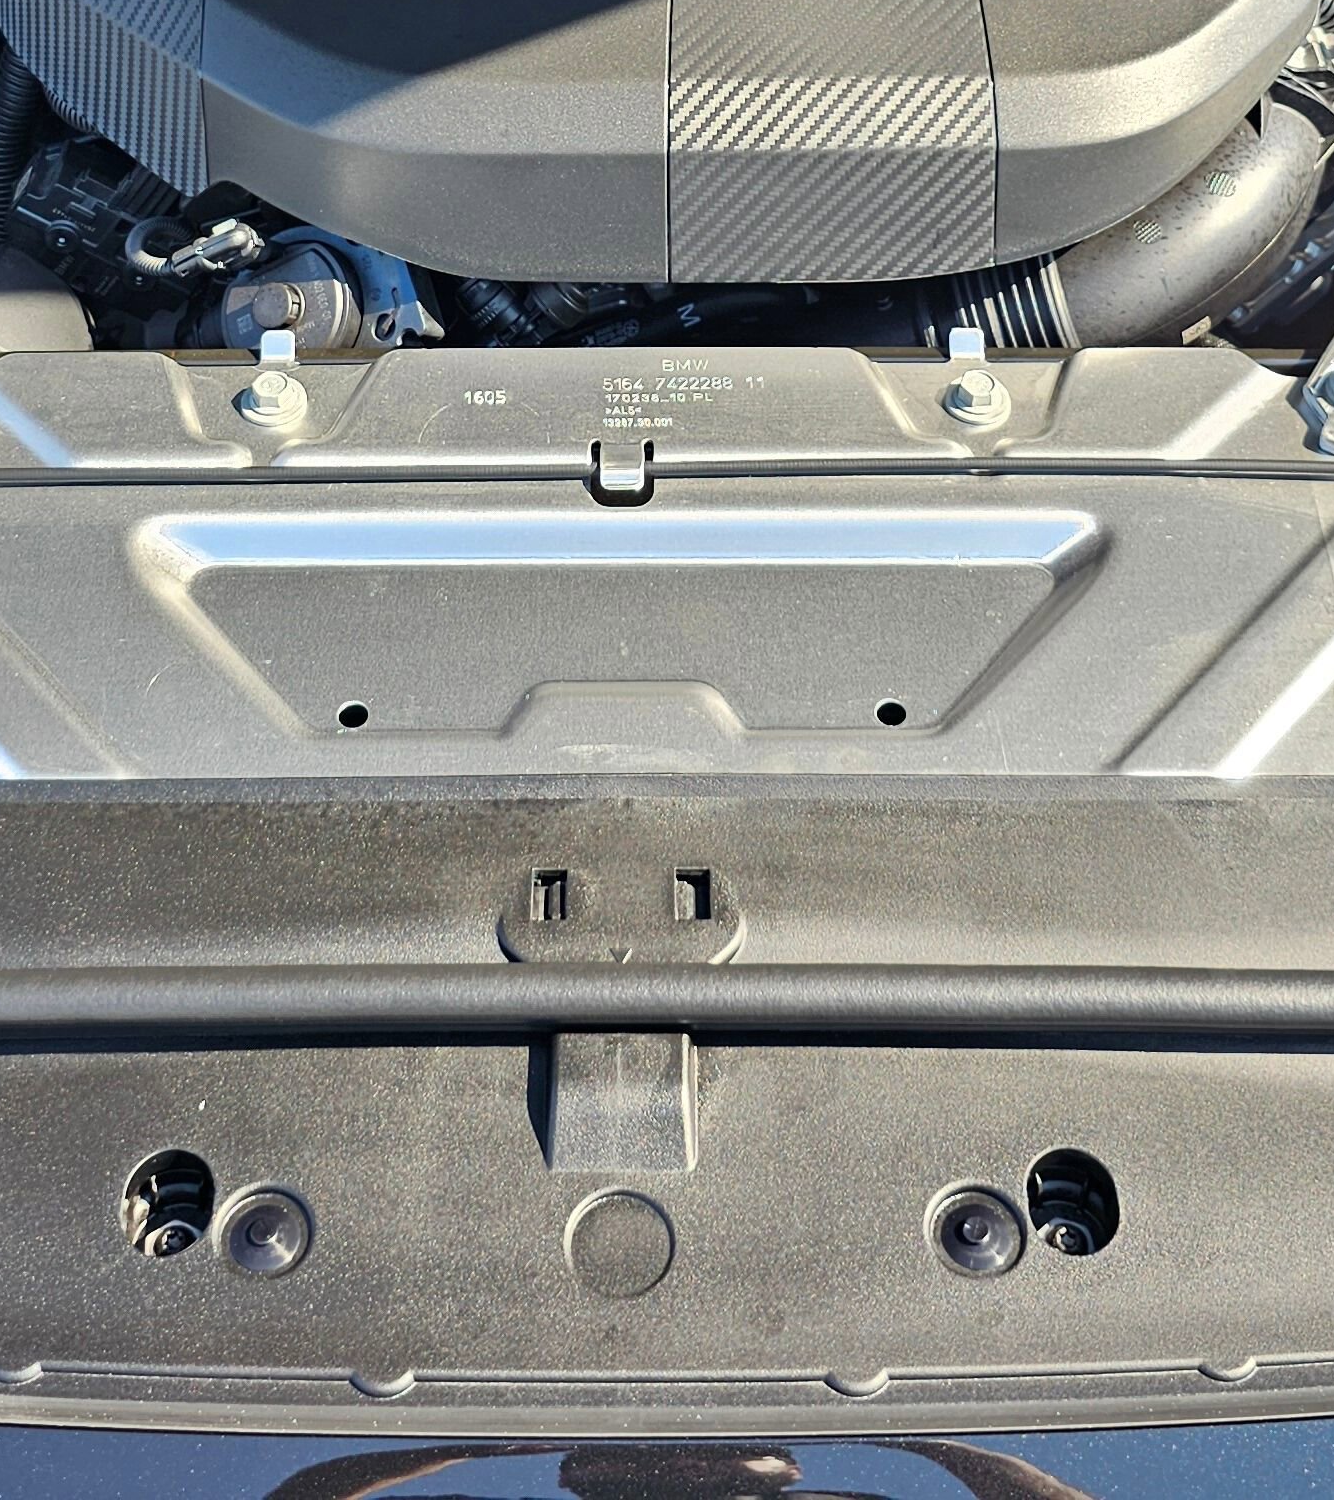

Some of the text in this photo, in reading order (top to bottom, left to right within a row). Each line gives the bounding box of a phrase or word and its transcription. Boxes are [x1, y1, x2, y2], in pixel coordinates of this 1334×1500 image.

[662, 359, 709, 372] BMW
[602, 376, 764, 392] 5164 7422288 11
[464, 390, 507, 405] 1605
[693, 392, 714, 402] PL
